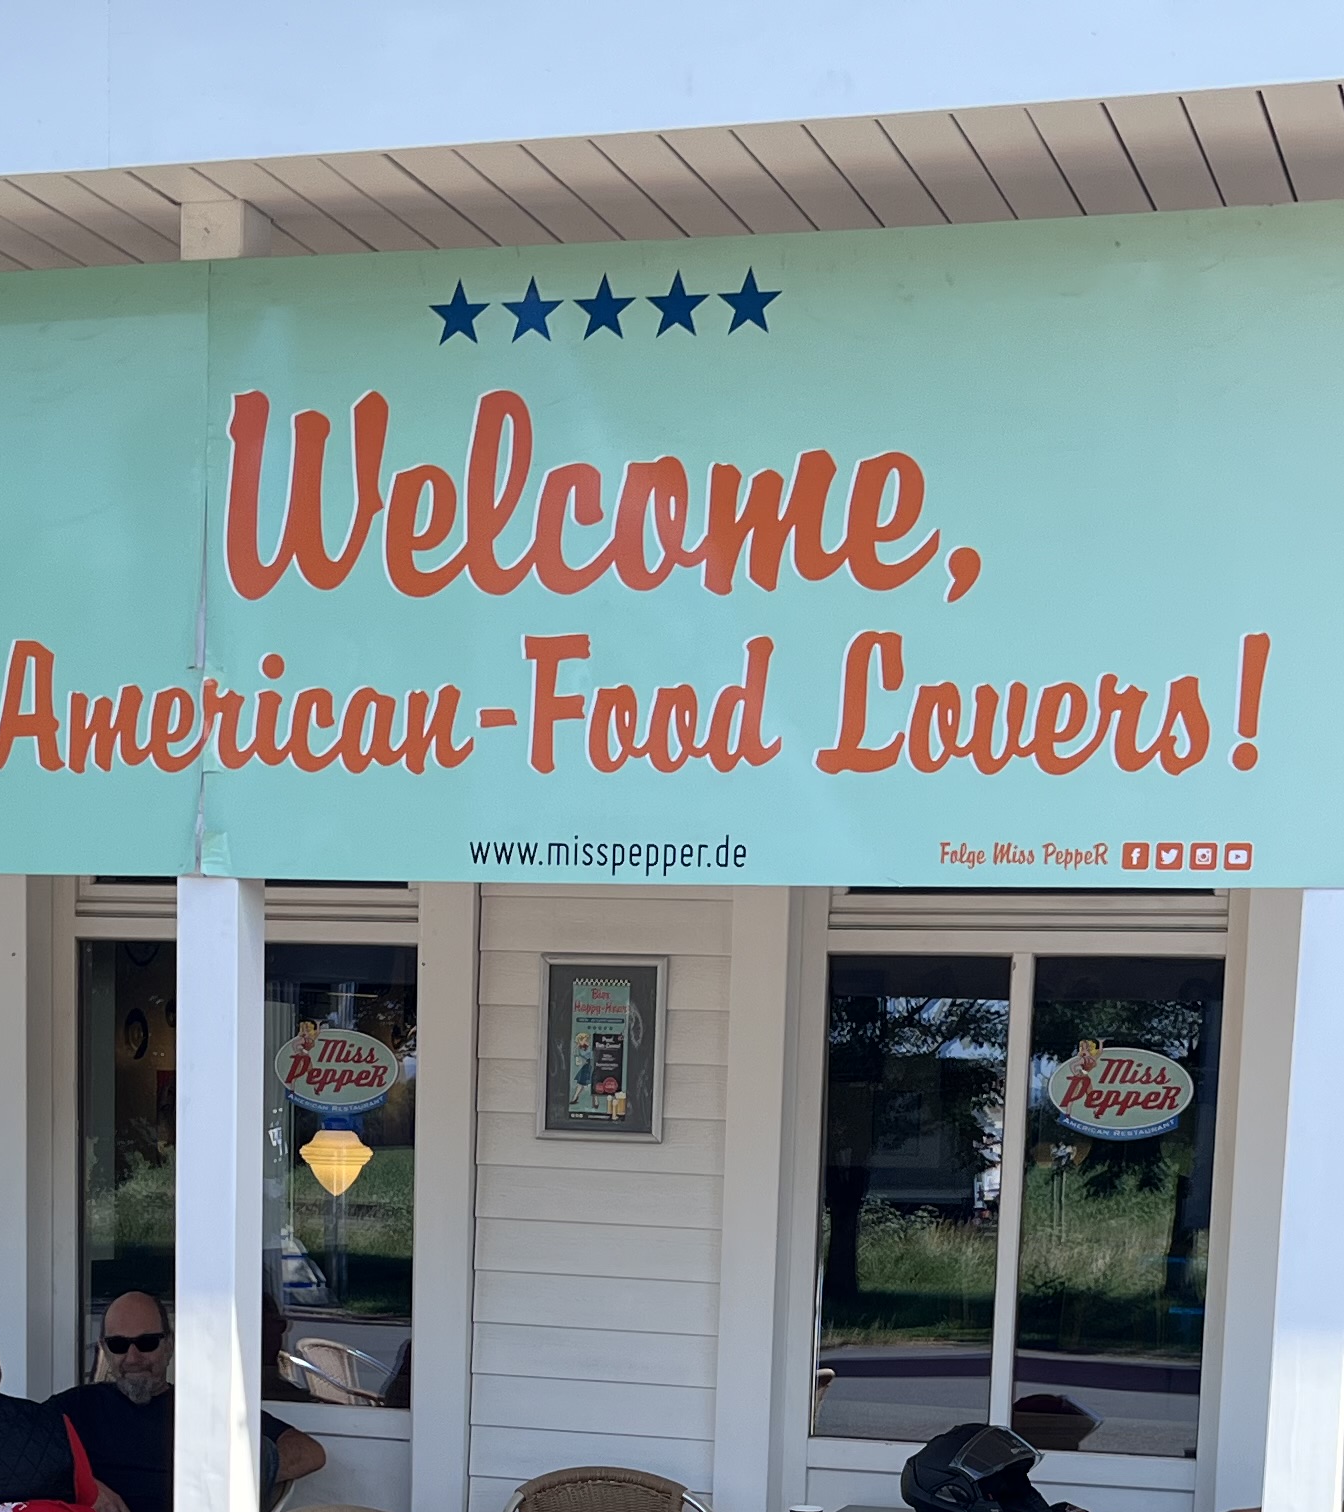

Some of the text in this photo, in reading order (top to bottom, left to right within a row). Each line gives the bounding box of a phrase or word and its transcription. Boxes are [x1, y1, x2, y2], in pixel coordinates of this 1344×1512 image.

[224, 388, 981, 603] Welcome,
[813, 629, 1271, 776] Lovers!
[469, 834, 748, 877] www.misspepper.de
[939, 841, 987, 870] Folge
[992, 841, 1036, 866] Miss
[317, 1038, 380, 1064] Miss
[1099, 1058, 1172, 1086] Miss
